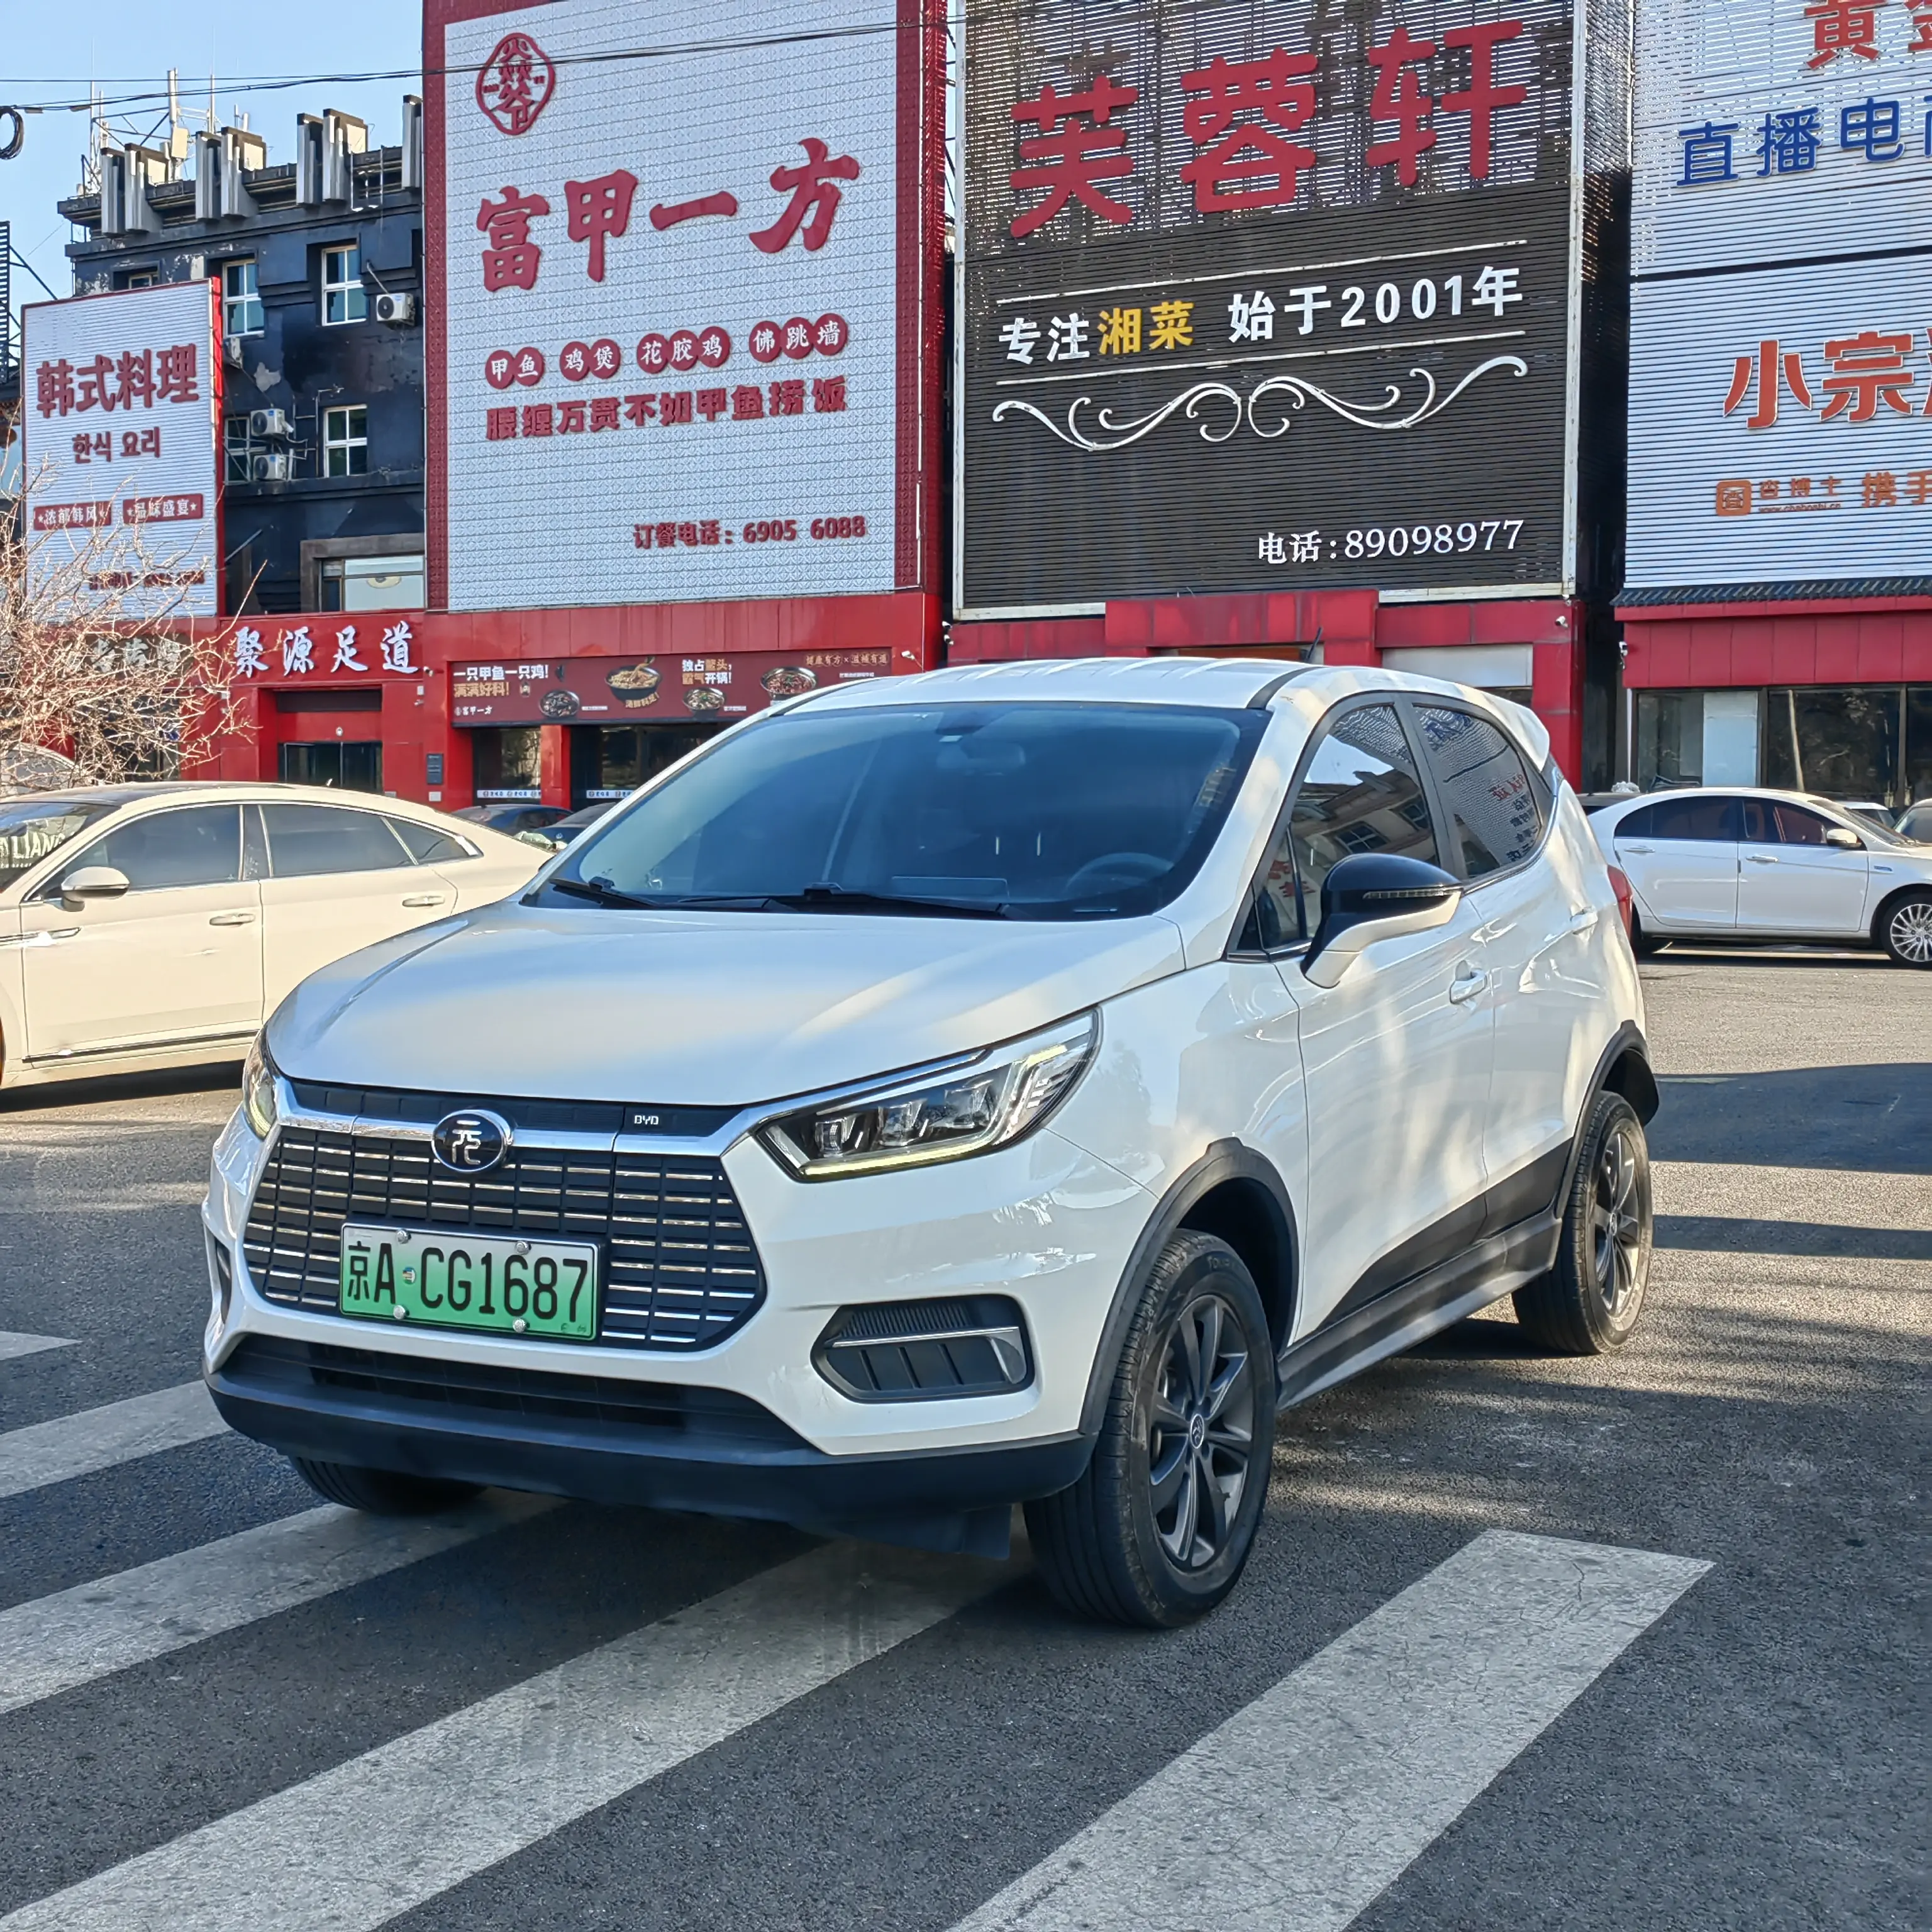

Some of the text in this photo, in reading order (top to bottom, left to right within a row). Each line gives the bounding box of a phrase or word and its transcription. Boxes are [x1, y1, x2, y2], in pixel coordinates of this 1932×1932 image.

[1805, 0, 1932, 69] 黄
[1010, 20, 1526, 238] 芙蓉轩
[1677, 96, 1932, 186] 直播电
[476, 136, 860, 292] 富甲一方
[997, 266, 1523, 364] 专注湘菜 始于2001年
[36, 343, 199, 418] 韩式料理
[491, 321, 841, 381] 甲鱼 鸡煲 花胶鸡 佛跳墙
[1723, 328, 1932, 429] 小宗
[486, 375, 847, 441] 腰缠万贯不如甲鱼捞饭
[72, 426, 160, 464] 한식 요리
[1759, 475, 1841, 499] 查博士
[810, 516, 865, 540] 6088
[233, 620, 419, 679] 聚源足道
[453, 664, 548, 681] 一只甲鱼一只鸡!
[453, 682, 509, 697] 满满好料!
[462, 705, 492, 716] 富甲一方
[452, 1119, 482, 1165] 元
[634, 1115, 659, 1125] BYD
